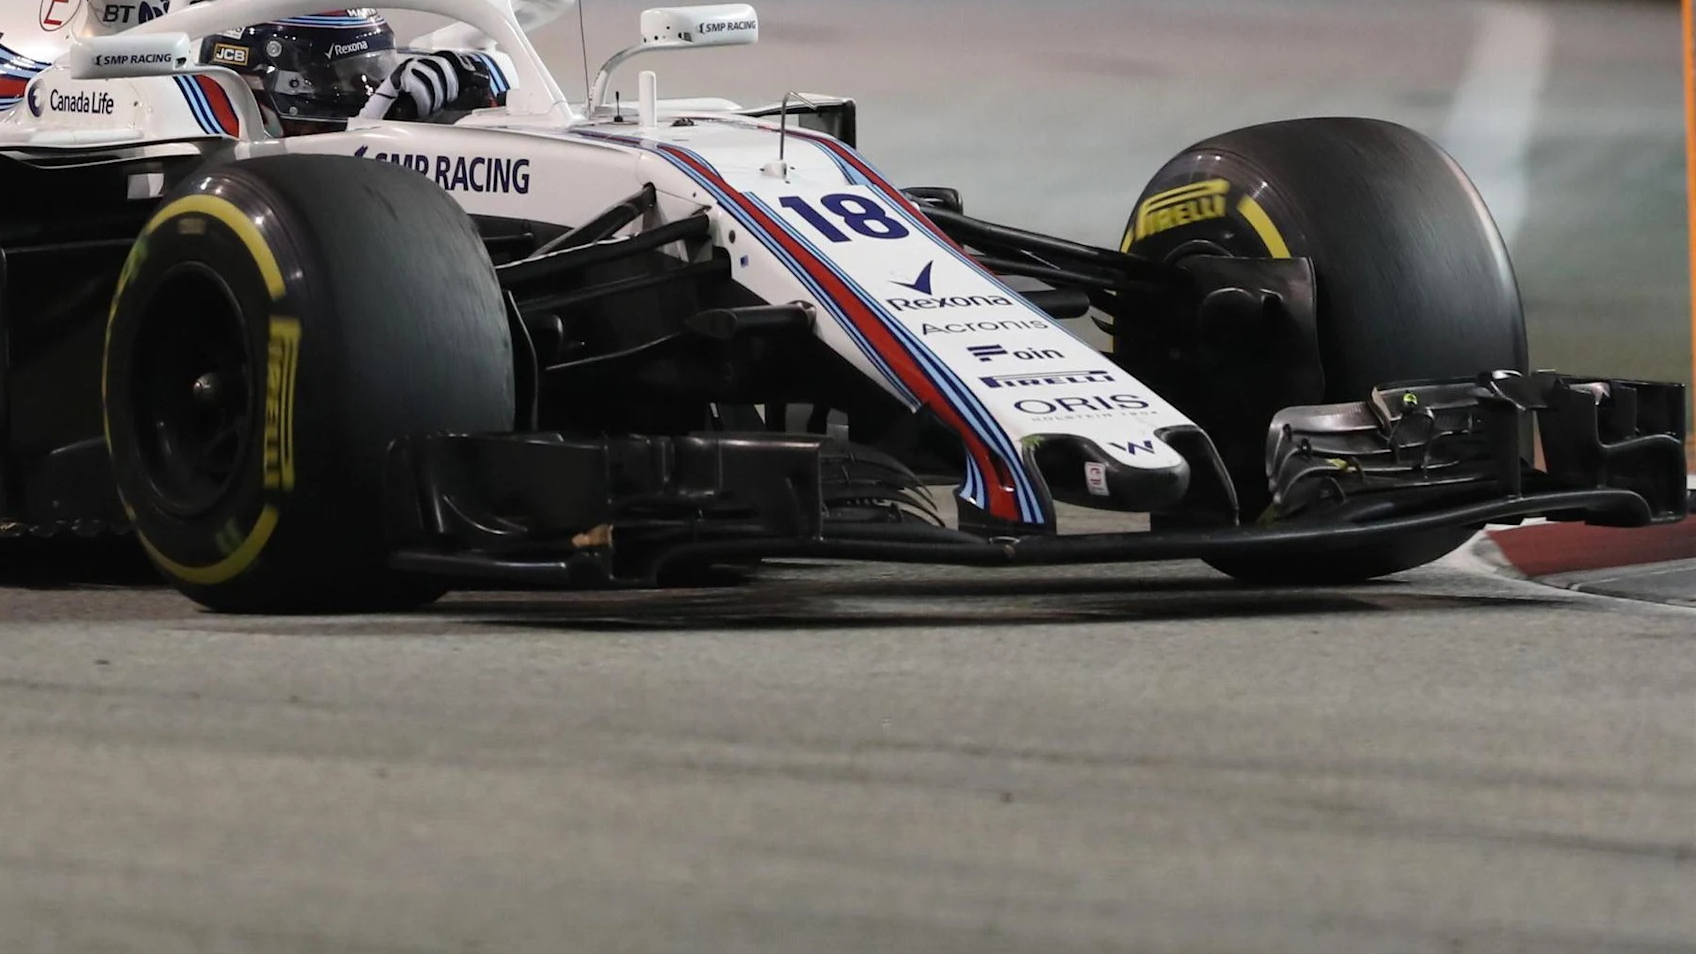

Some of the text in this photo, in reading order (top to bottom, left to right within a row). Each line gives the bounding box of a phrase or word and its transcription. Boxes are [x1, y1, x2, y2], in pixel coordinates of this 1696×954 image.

[102, 4, 136, 23] BT
[705, 20, 757, 33] SMP RACING
[215, 47, 246, 62] JCB
[335, 40, 369, 56] Rexona
[103, 53, 172, 66] SMP RACING
[50, 88, 114, 115] Canada Life
[435, 155, 531, 195] RACING
[779, 193, 910, 243] 18
[886, 293, 1014, 312] Rexona
[922, 317, 1049, 336] Acronis
[979, 370, 1116, 389] PIRELLI
[1014, 393, 1149, 415] ORIS
